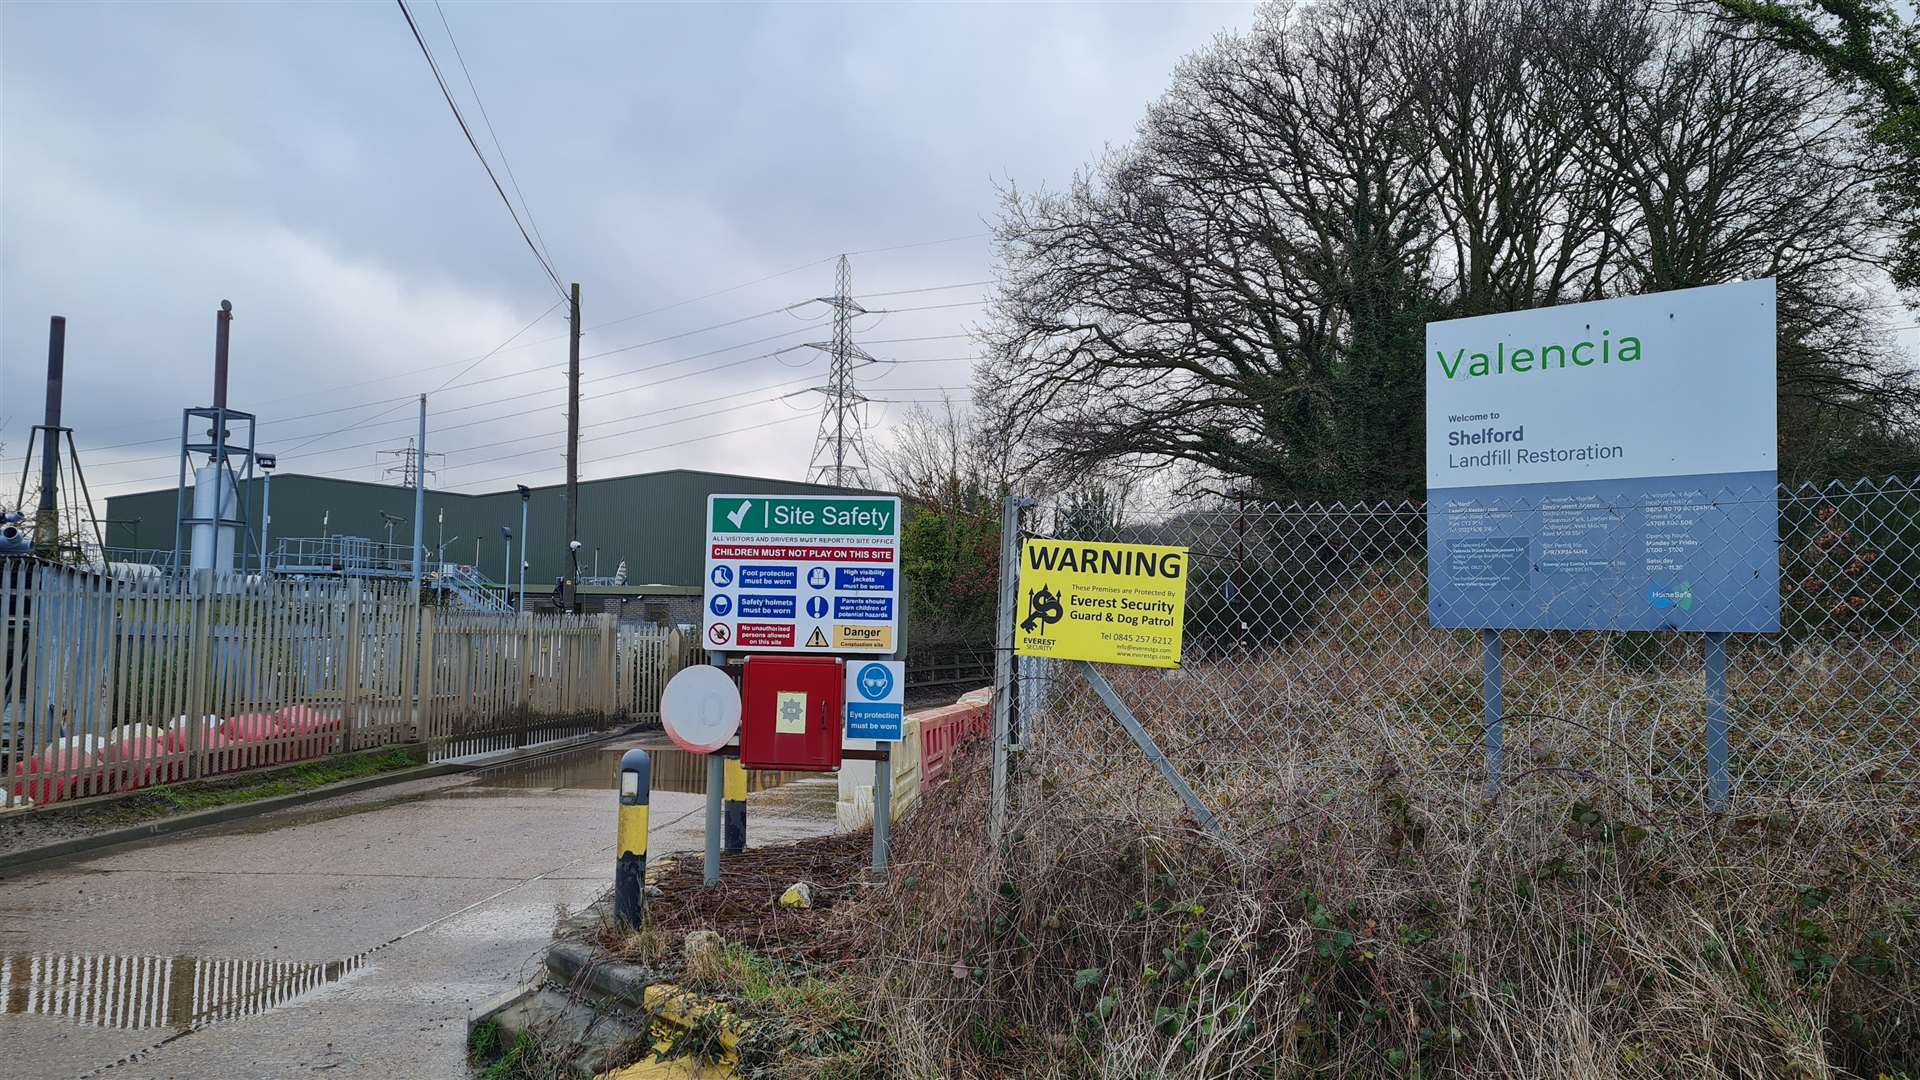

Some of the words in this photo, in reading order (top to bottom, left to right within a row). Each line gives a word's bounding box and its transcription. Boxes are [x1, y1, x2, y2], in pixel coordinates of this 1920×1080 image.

[1437, 330, 1641, 379] Valencia
[1449, 413, 1488, 423] Welcome
[1491, 412, 1500, 420] to
[1449, 426, 1523, 445] Shelford
[1449, 449, 1511, 468] Landfill
[1517, 443, 1623, 464] Restoration
[774, 506, 814, 525] Site
[822, 506, 889, 531] Safety
[714, 548, 759, 556] CHILDREN
[810, 550, 836, 558] PLAY
[872, 551, 891, 559] SITE
[1029, 546, 1181, 579] WARNING
[1092, 585, 1120, 593] Premises
[1134, 588, 1166, 596] Protected
[1071, 595, 1117, 608] Everest
[1121, 598, 1174, 615] Security
[1070, 611, 1101, 621] Guard
[1105, 613, 1113, 622] &
[1118, 614, 1138, 626] Dog
[1142, 617, 1174, 626] Patrol
[844, 627, 880, 638] Danger
[1101, 632, 1112, 640] Tel
[1113, 633, 1133, 642] 0845
[1135, 635, 1151, 643] 257
[1152, 636, 1172, 645] 6212
[849, 711, 862, 719] Eye
